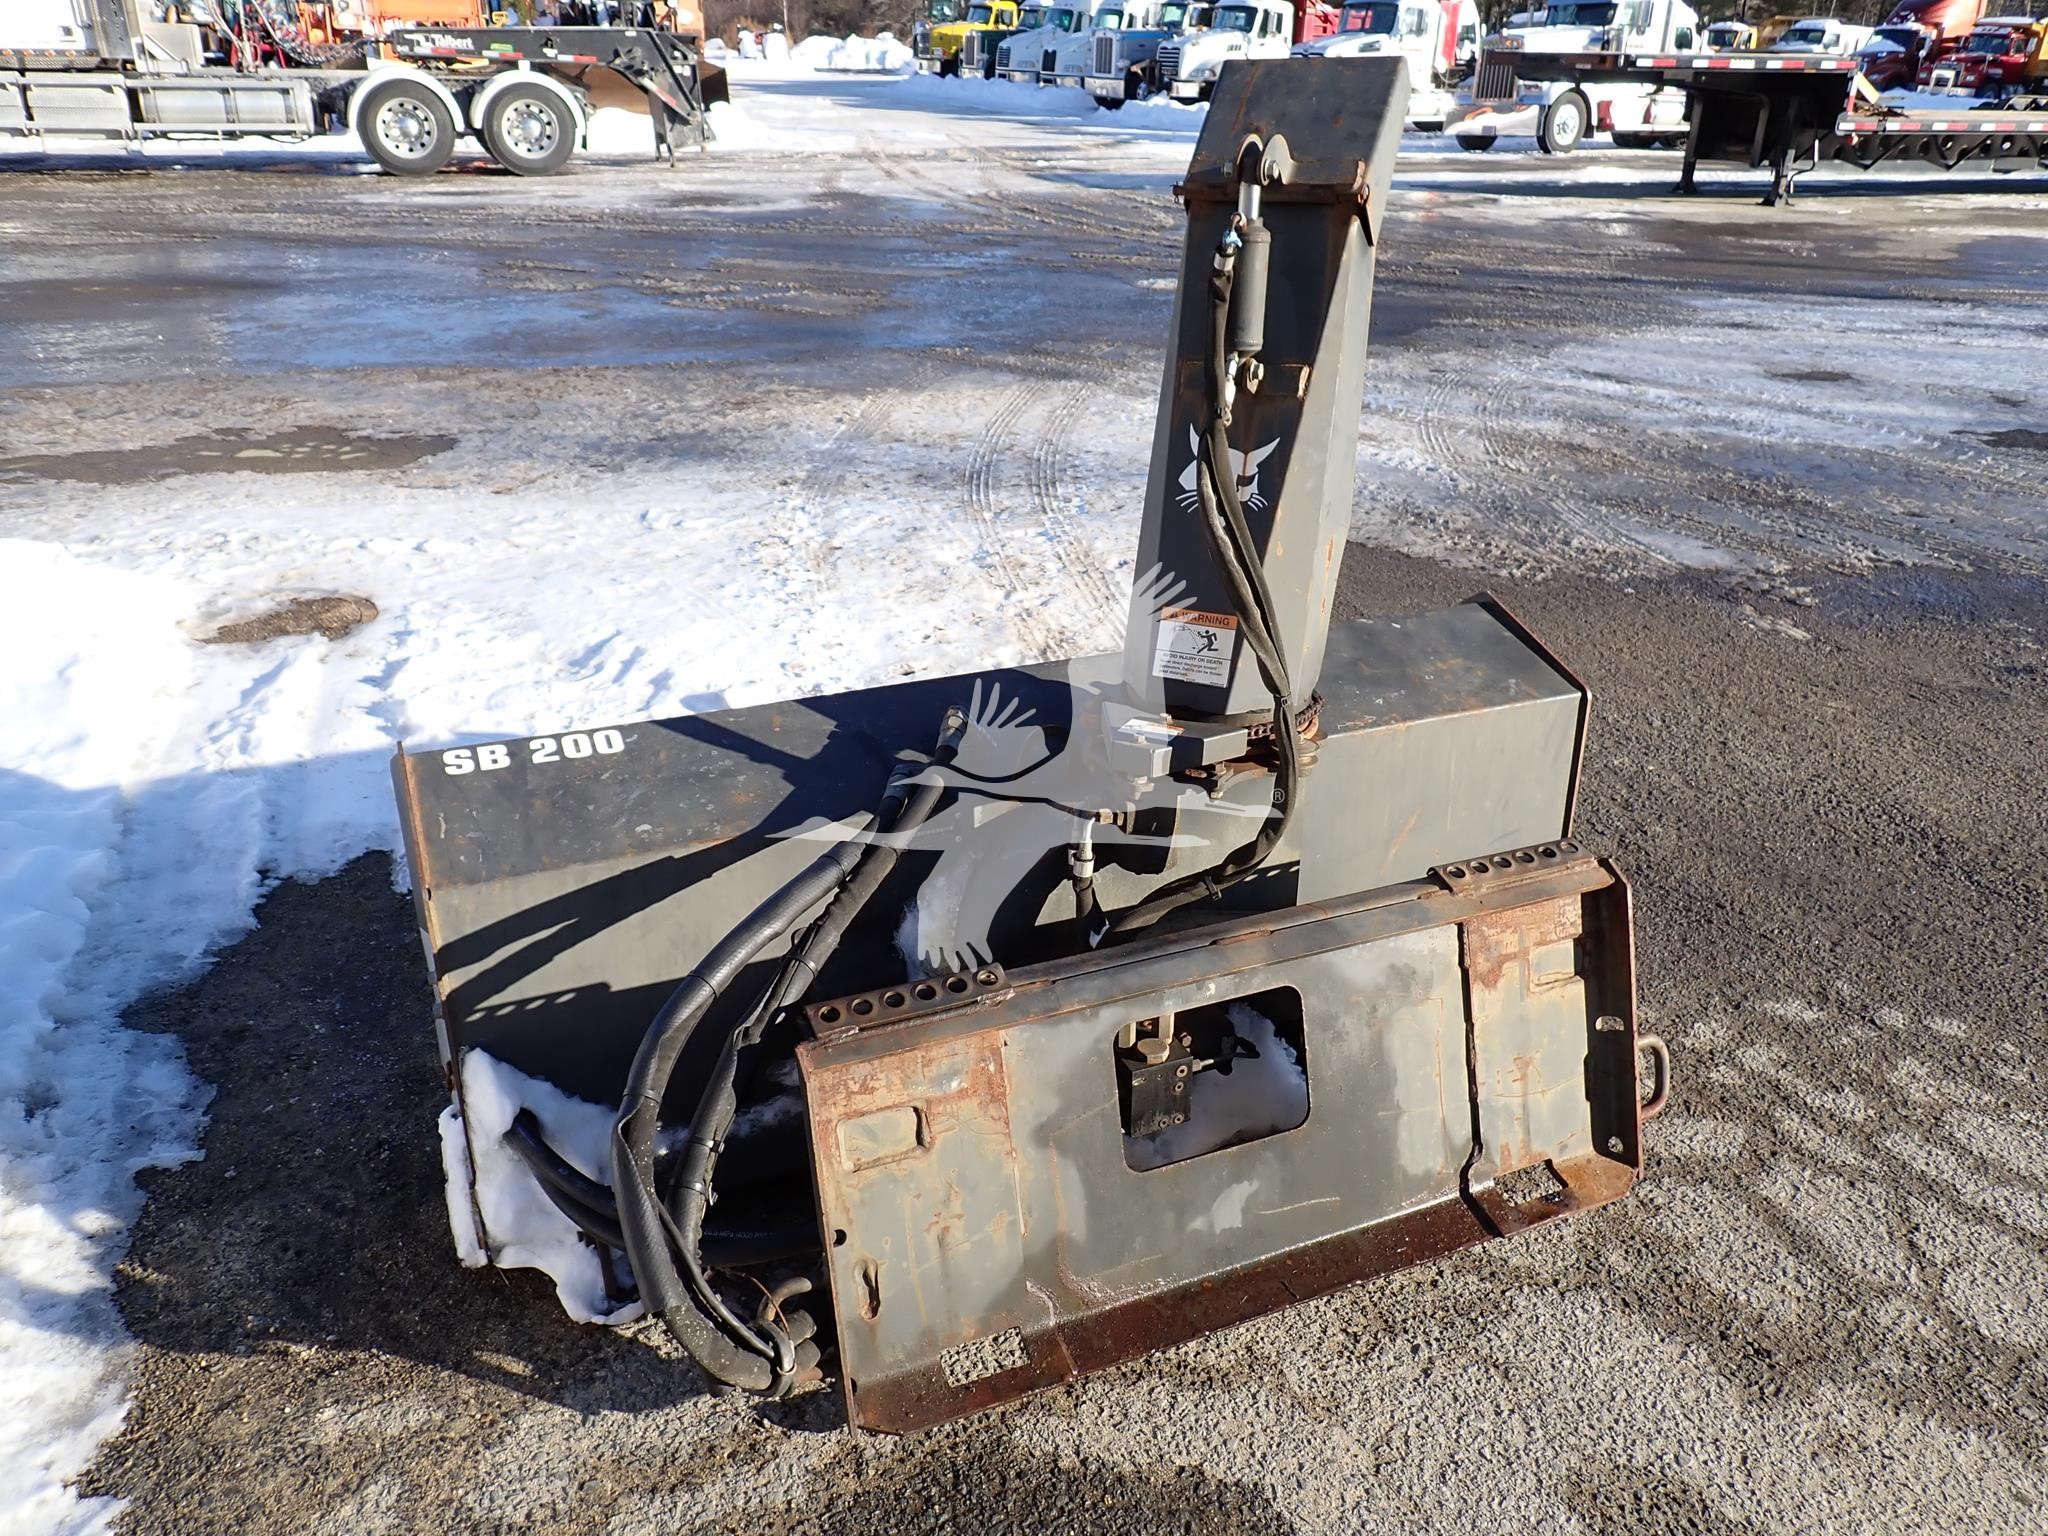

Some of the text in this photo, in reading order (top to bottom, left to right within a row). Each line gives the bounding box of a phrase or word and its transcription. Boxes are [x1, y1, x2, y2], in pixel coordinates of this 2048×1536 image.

[431, 33, 474, 49] Talbert
[1206, 658, 1223, 666] DEATH
[442, 729, 626, 776] SB 200
